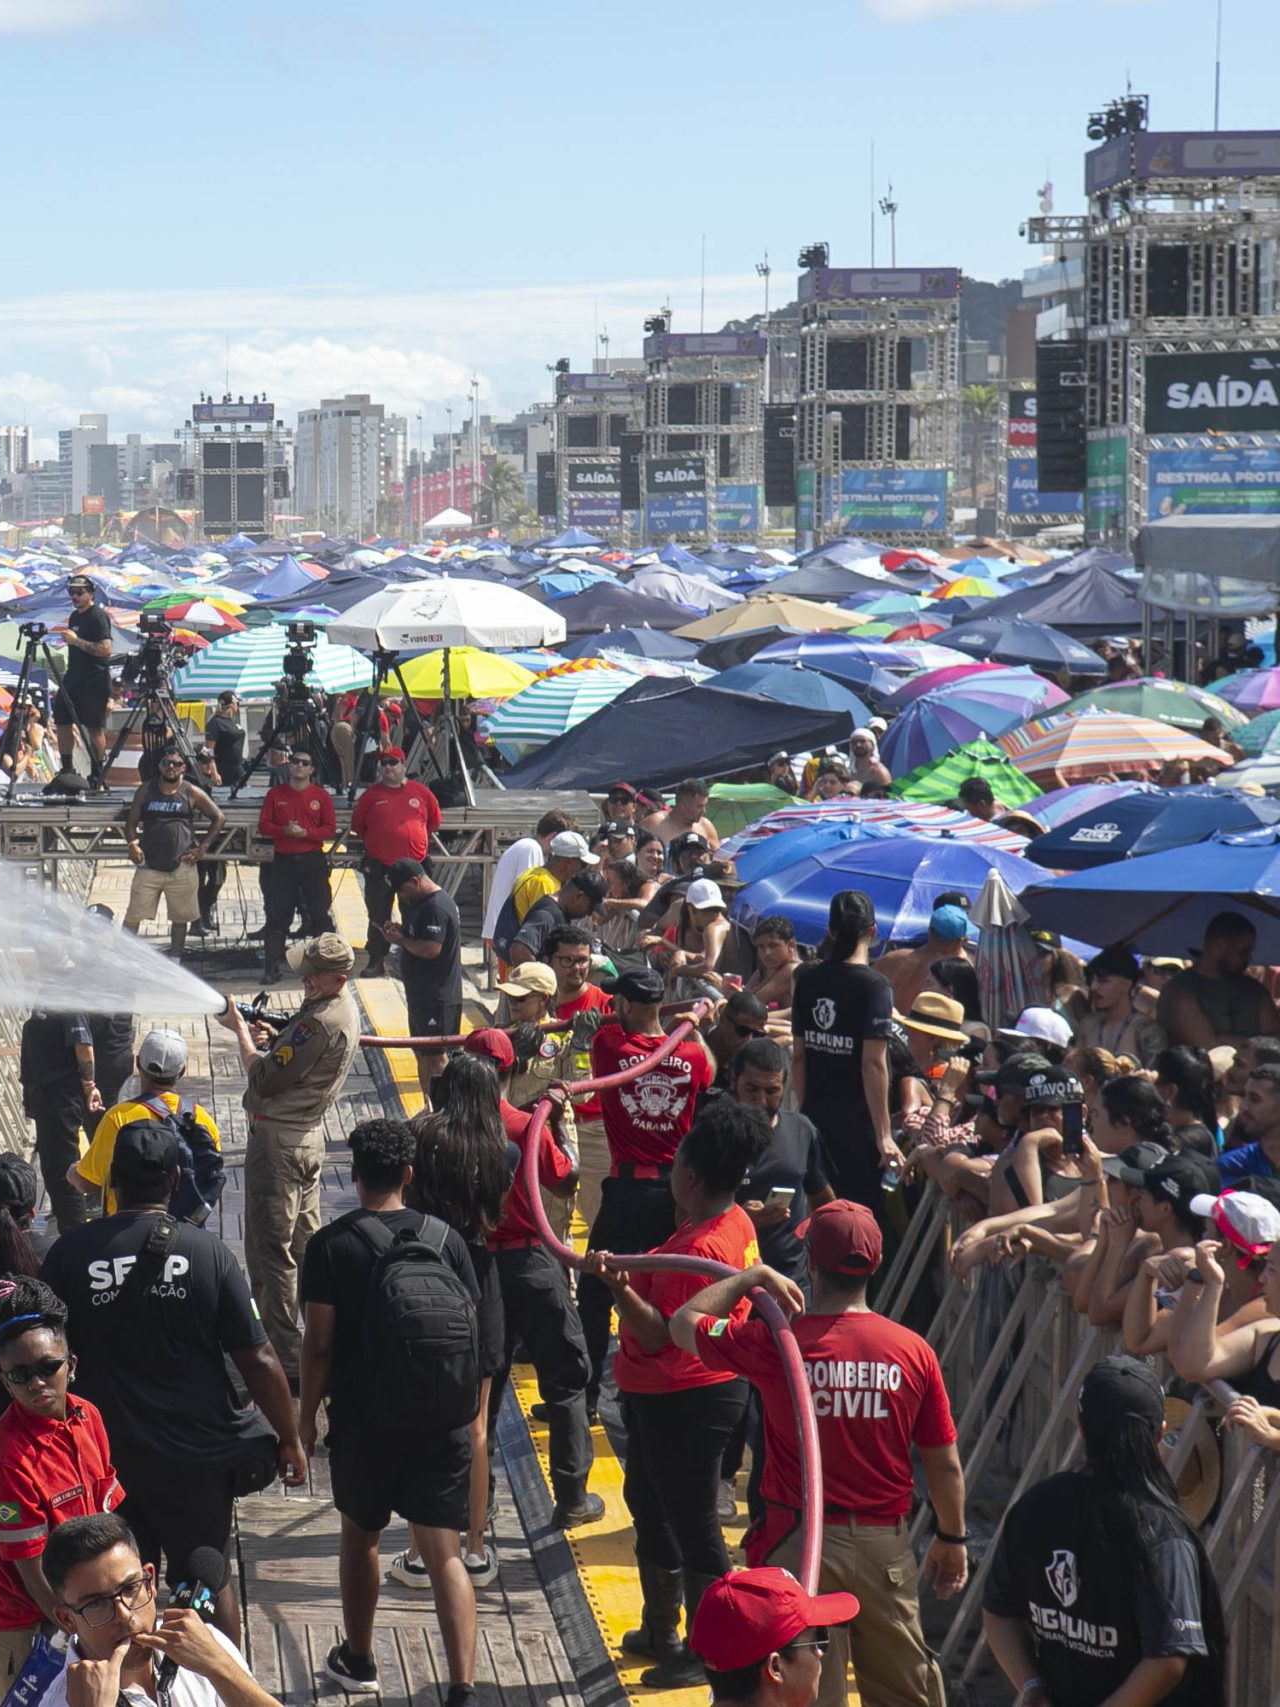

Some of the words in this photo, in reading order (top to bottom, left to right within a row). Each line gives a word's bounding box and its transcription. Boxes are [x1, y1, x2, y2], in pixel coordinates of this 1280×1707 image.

[1166, 375, 1279, 409] SAÍDA
[576, 471, 615, 484] SAÍDA
[654, 468, 698, 483] SAÍDA
[1156, 471, 1232, 484] RESTINGA
[619, 1055, 692, 1073] BOEIRO
[632, 1118, 674, 1132] PARANÁ
[92, 1283, 187, 1306] COMAÇÃO
[804, 1360, 902, 1392] BOMBEIRO
[813, 1389, 889, 1418] CIVIL
